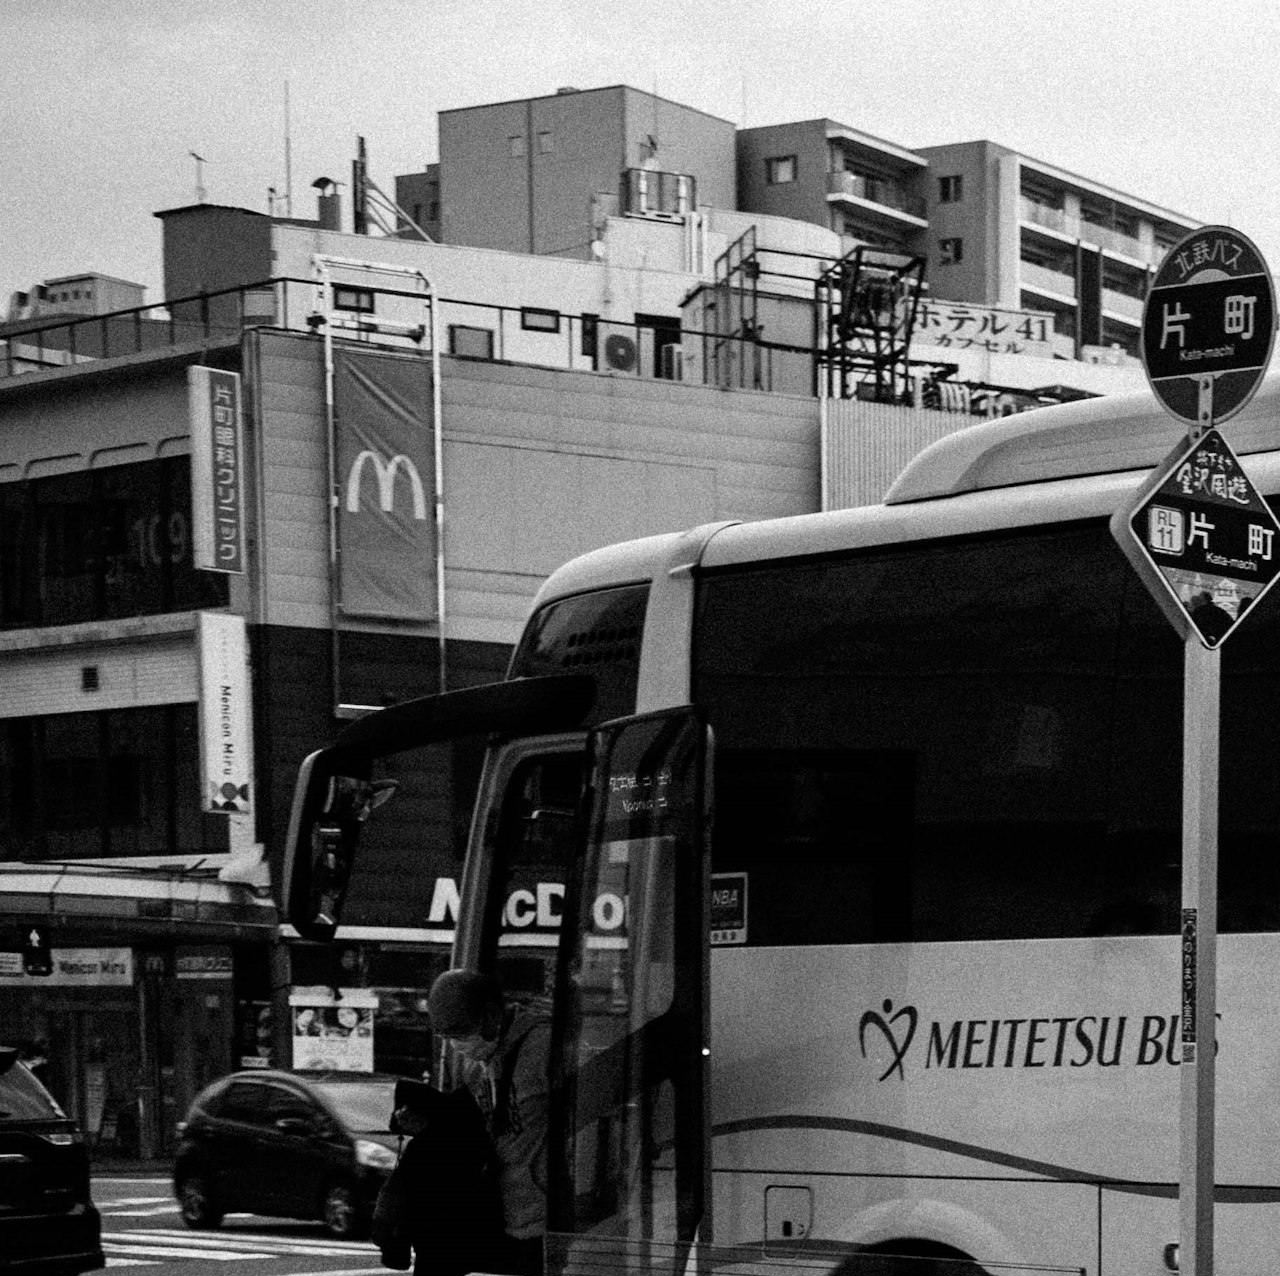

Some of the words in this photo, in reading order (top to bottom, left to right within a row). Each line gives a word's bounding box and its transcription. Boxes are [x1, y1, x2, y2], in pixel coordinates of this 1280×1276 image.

[915, 304, 1008, 335] ホテル
[1015, 318, 1048, 341] 41
[1180, 343, 1235, 360] Kata-machi
[1177, 462, 1250, 504] 金沢周遊
[1158, 511, 1176, 527] RL
[1157, 527, 1173, 549] 11
[1205, 551, 1258, 572] Kata-machi
[221, 685, 233, 738] Menicon
[223, 743, 234, 776] Miru
[926, 1015, 1128, 1069] MEITETSU
[1136, 1014, 1221, 1067] BU
